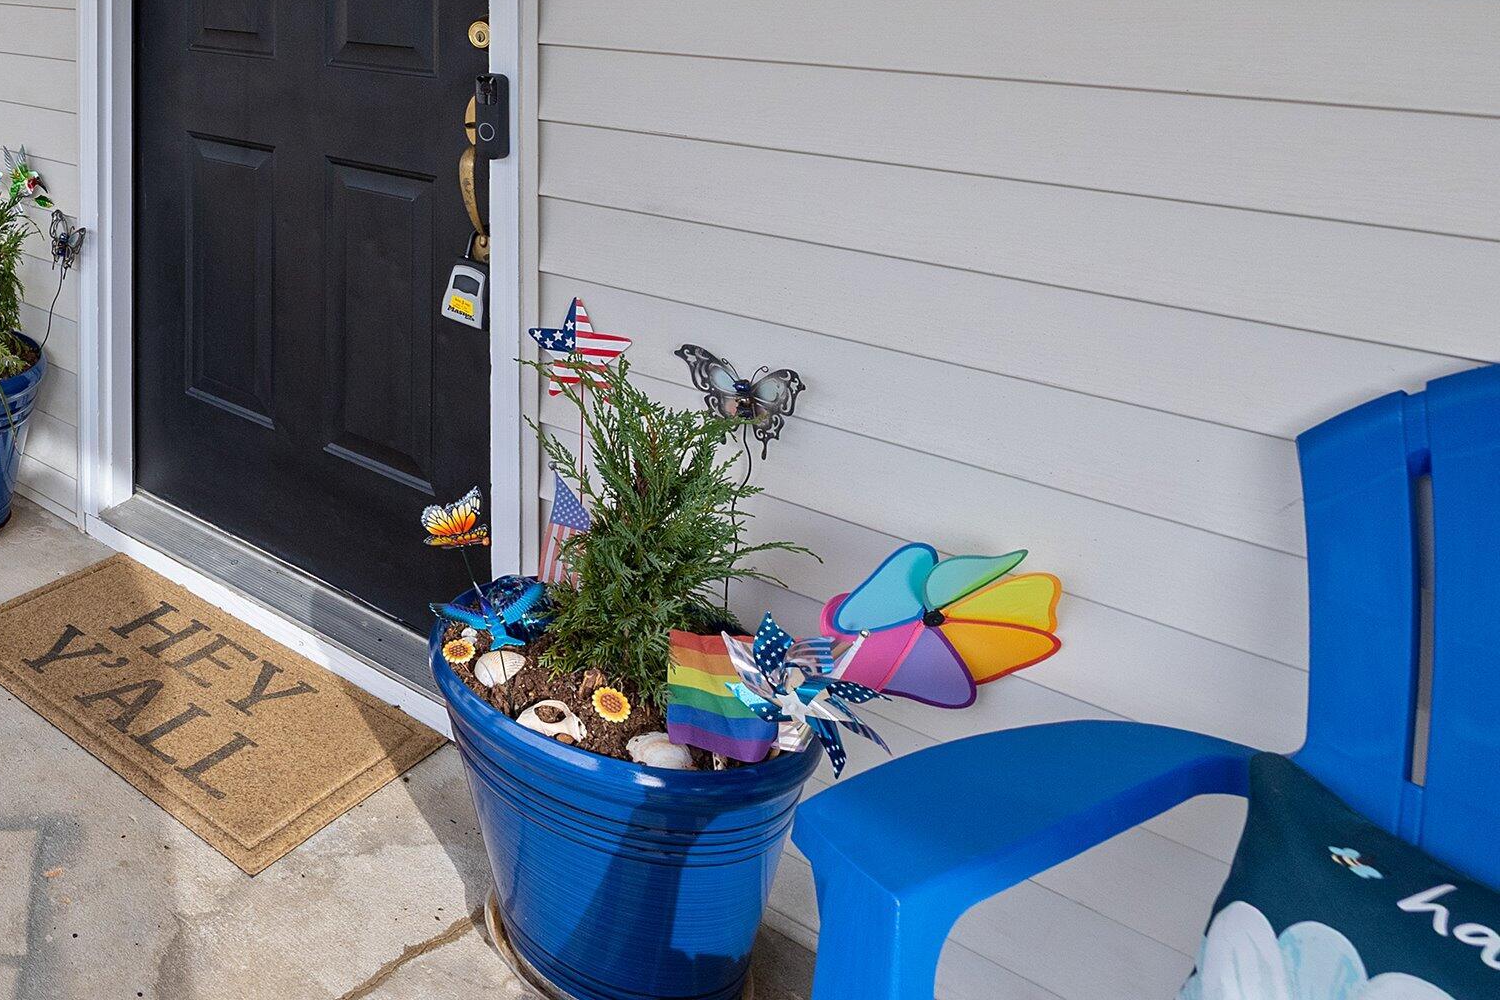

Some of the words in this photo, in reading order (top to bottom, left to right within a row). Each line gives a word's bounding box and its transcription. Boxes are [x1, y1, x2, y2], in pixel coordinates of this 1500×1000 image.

[22, 624, 259, 801] Y'ALL
[109, 601, 317, 717] HEY
[1396, 883, 1500, 971] ha
